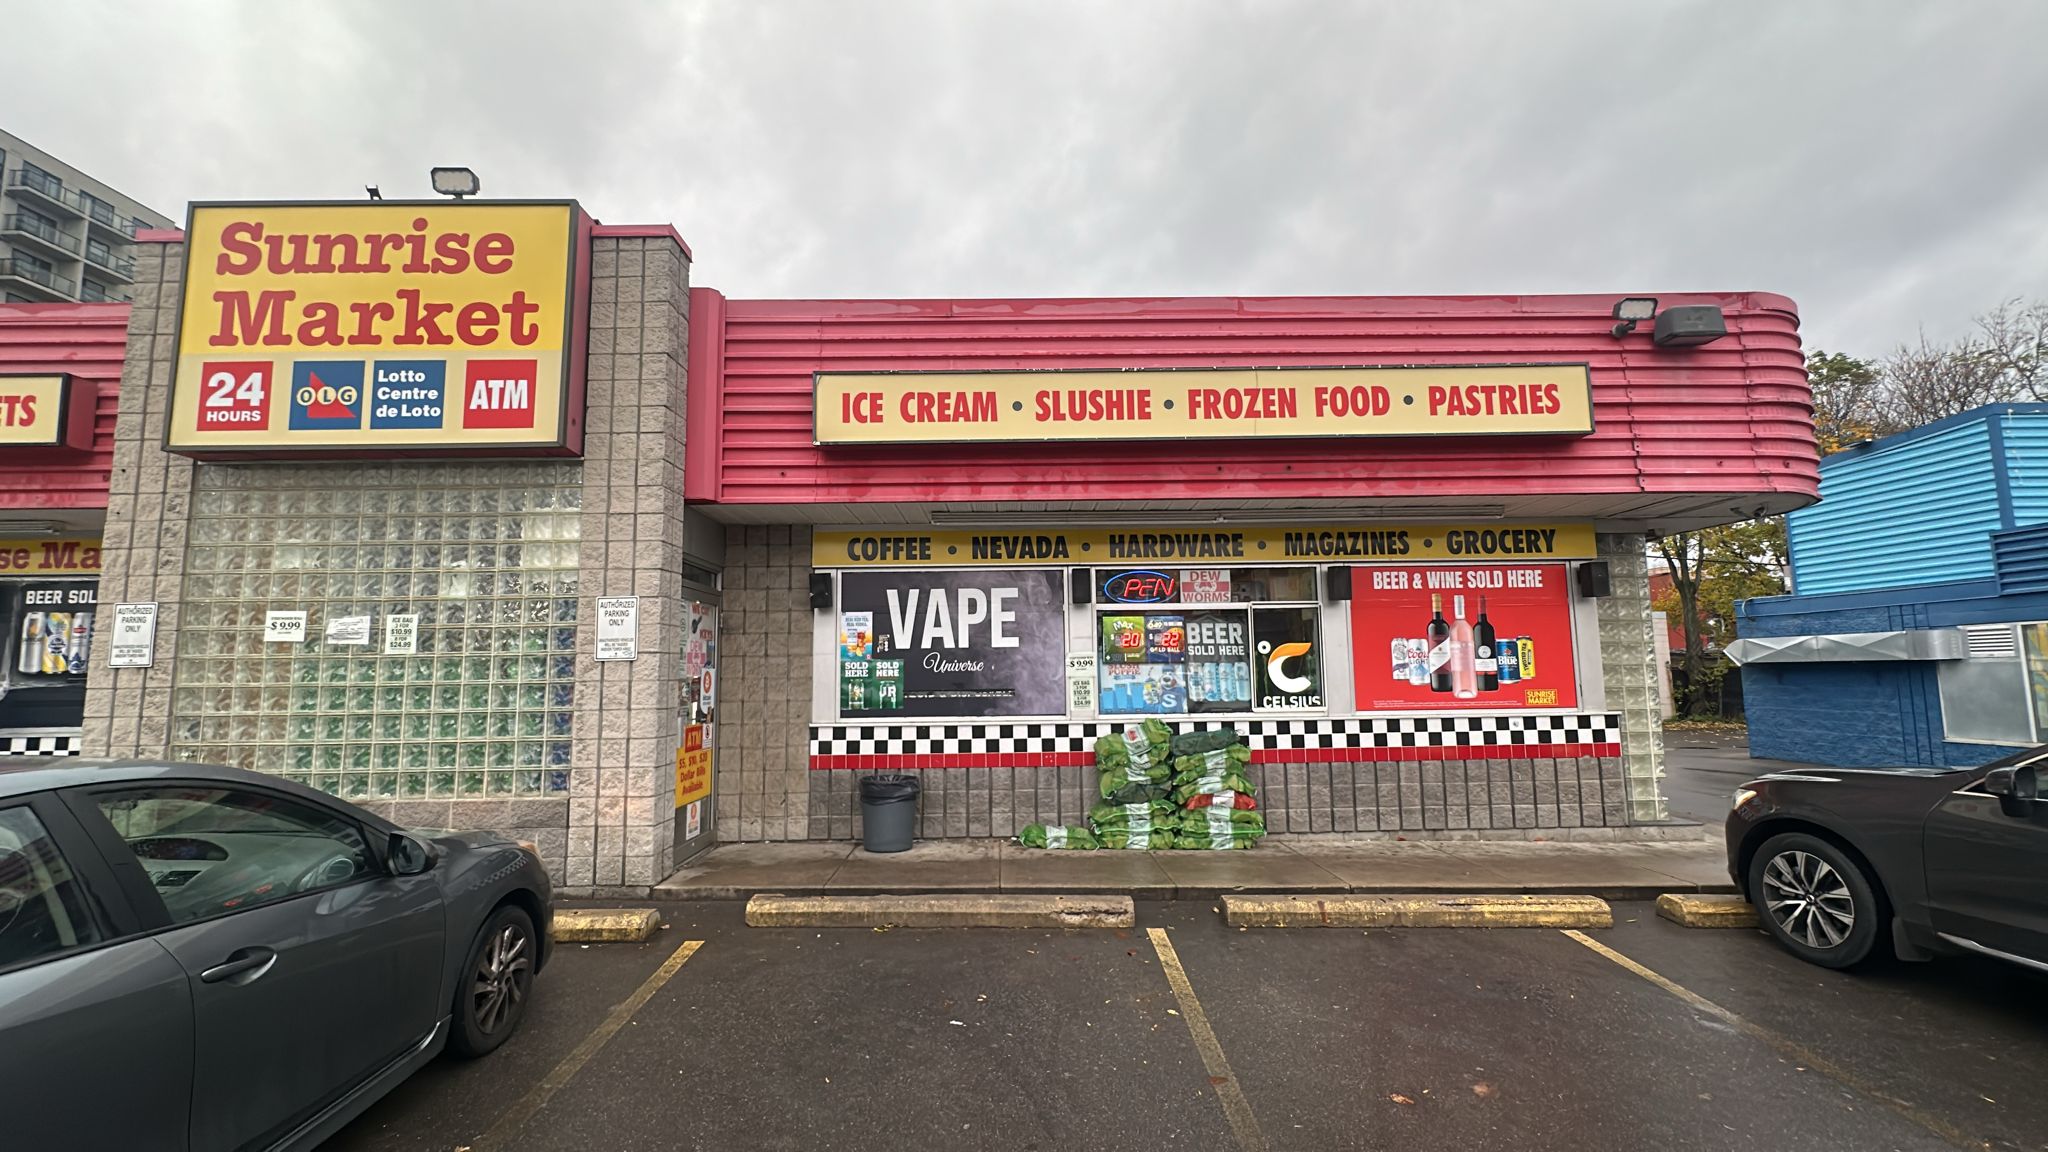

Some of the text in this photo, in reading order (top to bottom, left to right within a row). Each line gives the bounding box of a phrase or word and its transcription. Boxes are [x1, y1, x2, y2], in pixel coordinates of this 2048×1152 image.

[216, 217, 515, 275] Sunrise
[208, 289, 540, 346] Market
[377, 369, 426, 383] Lotto
[205, 371, 265, 407] 24
[297, 387, 357, 405] OLG
[376, 387, 439, 401] Centre
[469, 379, 528, 410] ATM
[842, 383, 1561, 423] ICE CREAM SLUSHIE FROZEN FOOD PASTRIES
[0, 395, 37, 427] TS
[206, 410, 262, 422] HOURS
[376, 405, 441, 418] de Loto
[847, 528, 1556, 561] COFFEE NEVADA HARDWARE MAGAZINES GROCERY
[1189, 571, 1221, 582] DEW
[1373, 569, 1543, 589] BEER & WINE SOLD HERE
[25, 590, 62, 604] BEER
[1182, 592, 1230, 602] WORMS
[604, 609, 630, 617] PARKING
[886, 587, 1020, 650] VAPE
[280, 621, 301, 630] 9.99
[608, 618, 624, 626] ONLY
[1122, 632, 1140, 647] 20
[1161, 632, 1179, 647] 22
[1186, 622, 1243, 644] BEER
[1187, 645, 1245, 655] SOLD HERE
[923, 652, 985, 673] Universe
[1498, 655, 1518, 665] Blue
[1263, 695, 1321, 708] CELSIUS
[1527, 696, 1556, 704] MARKET
[686, 731, 702, 747] ATM
